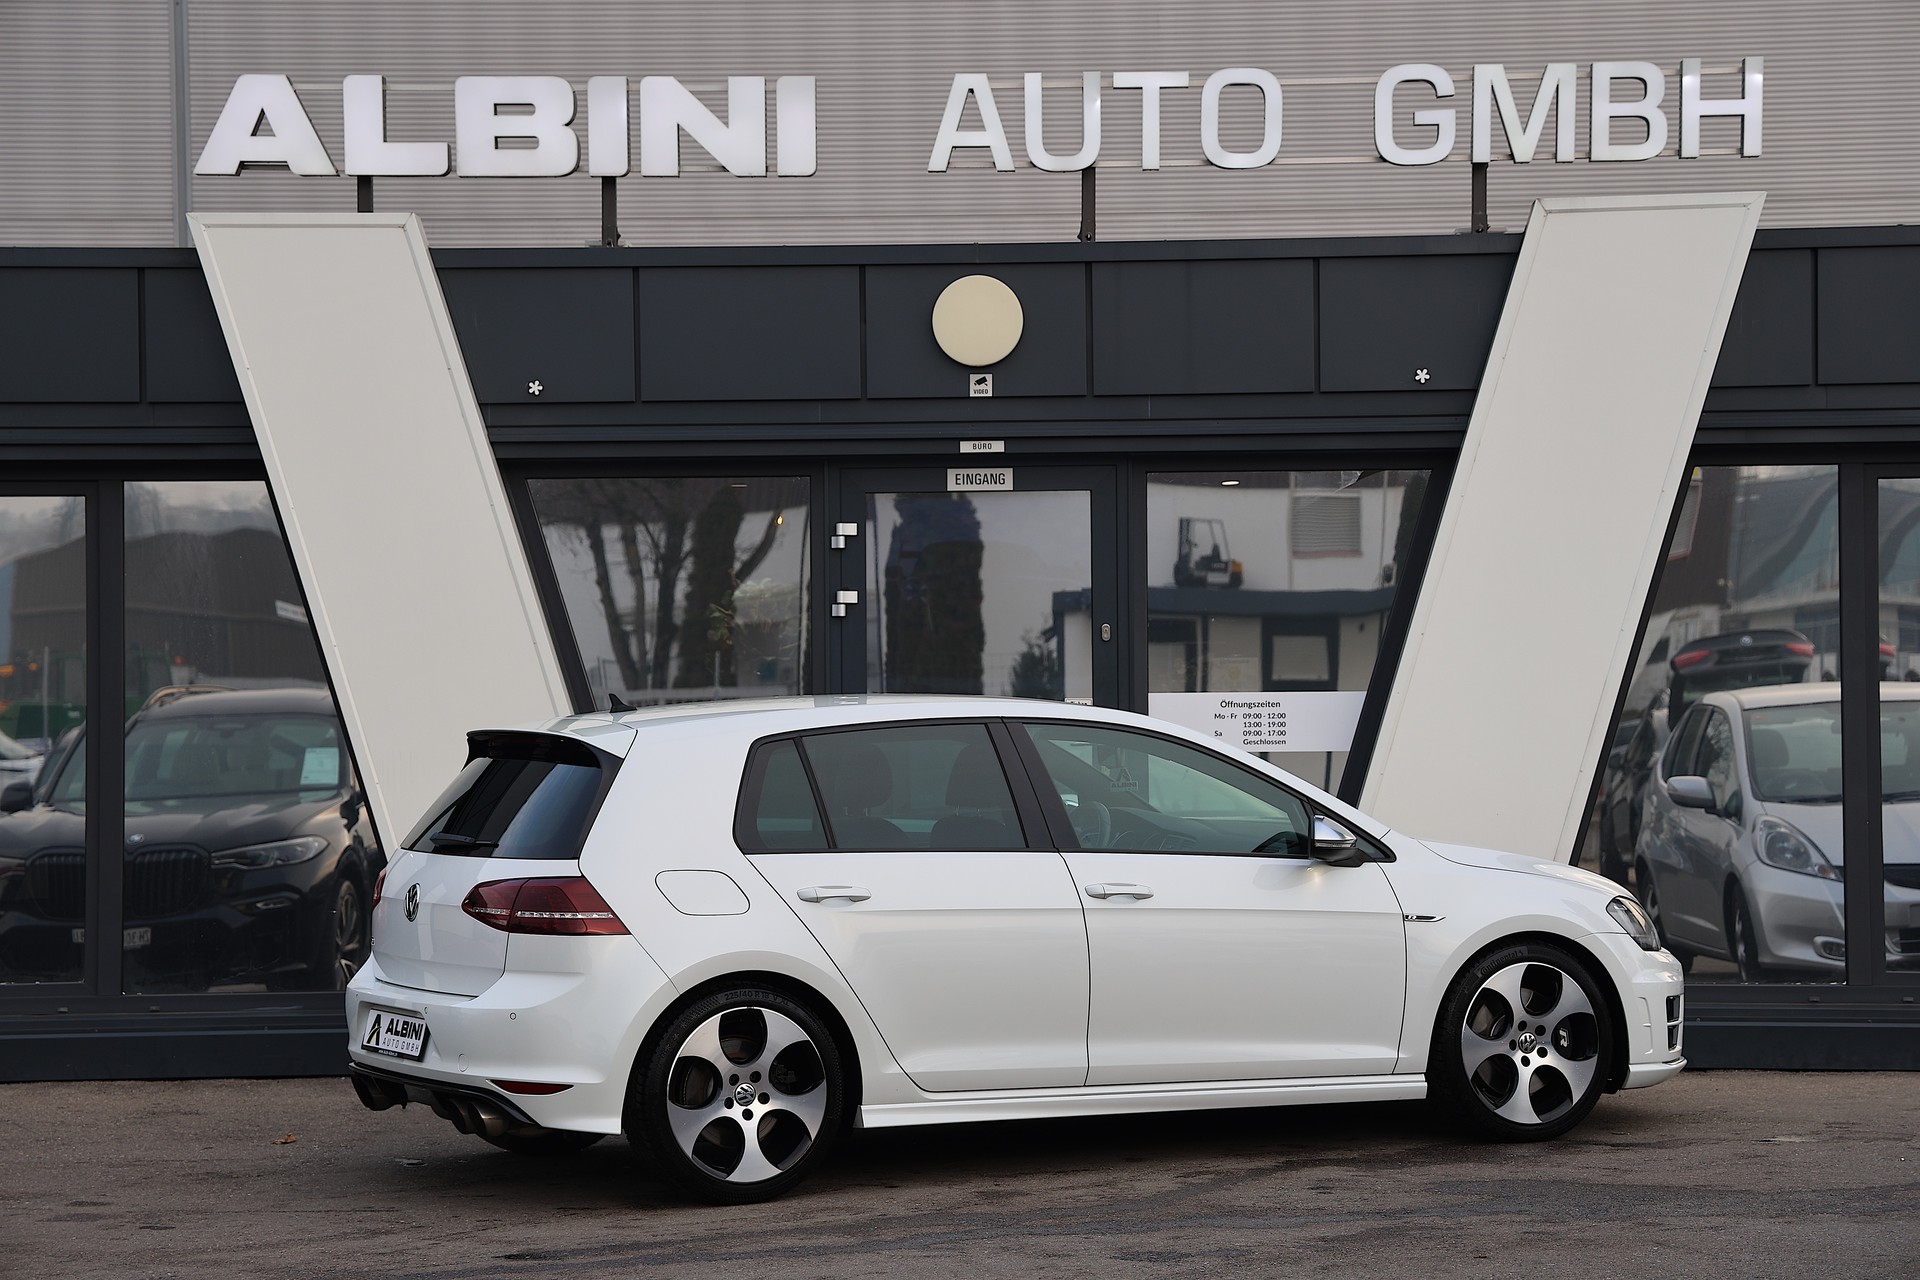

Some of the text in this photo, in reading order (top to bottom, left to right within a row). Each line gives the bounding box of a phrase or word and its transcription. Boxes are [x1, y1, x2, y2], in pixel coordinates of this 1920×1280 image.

[193, 56, 1764, 177] ALBINI AUTO GMBH
[972, 442, 992, 450] BÜRO
[955, 472, 1006, 485] EINGANG
[1220, 699, 1281, 709] Öffnungszeiten
[724, 990, 753, 1001] 225/40
[385, 1018, 424, 1041] ALBINI
[382, 1037, 399, 1049] AUTO
[401, 1041, 420, 1053] GMBH
